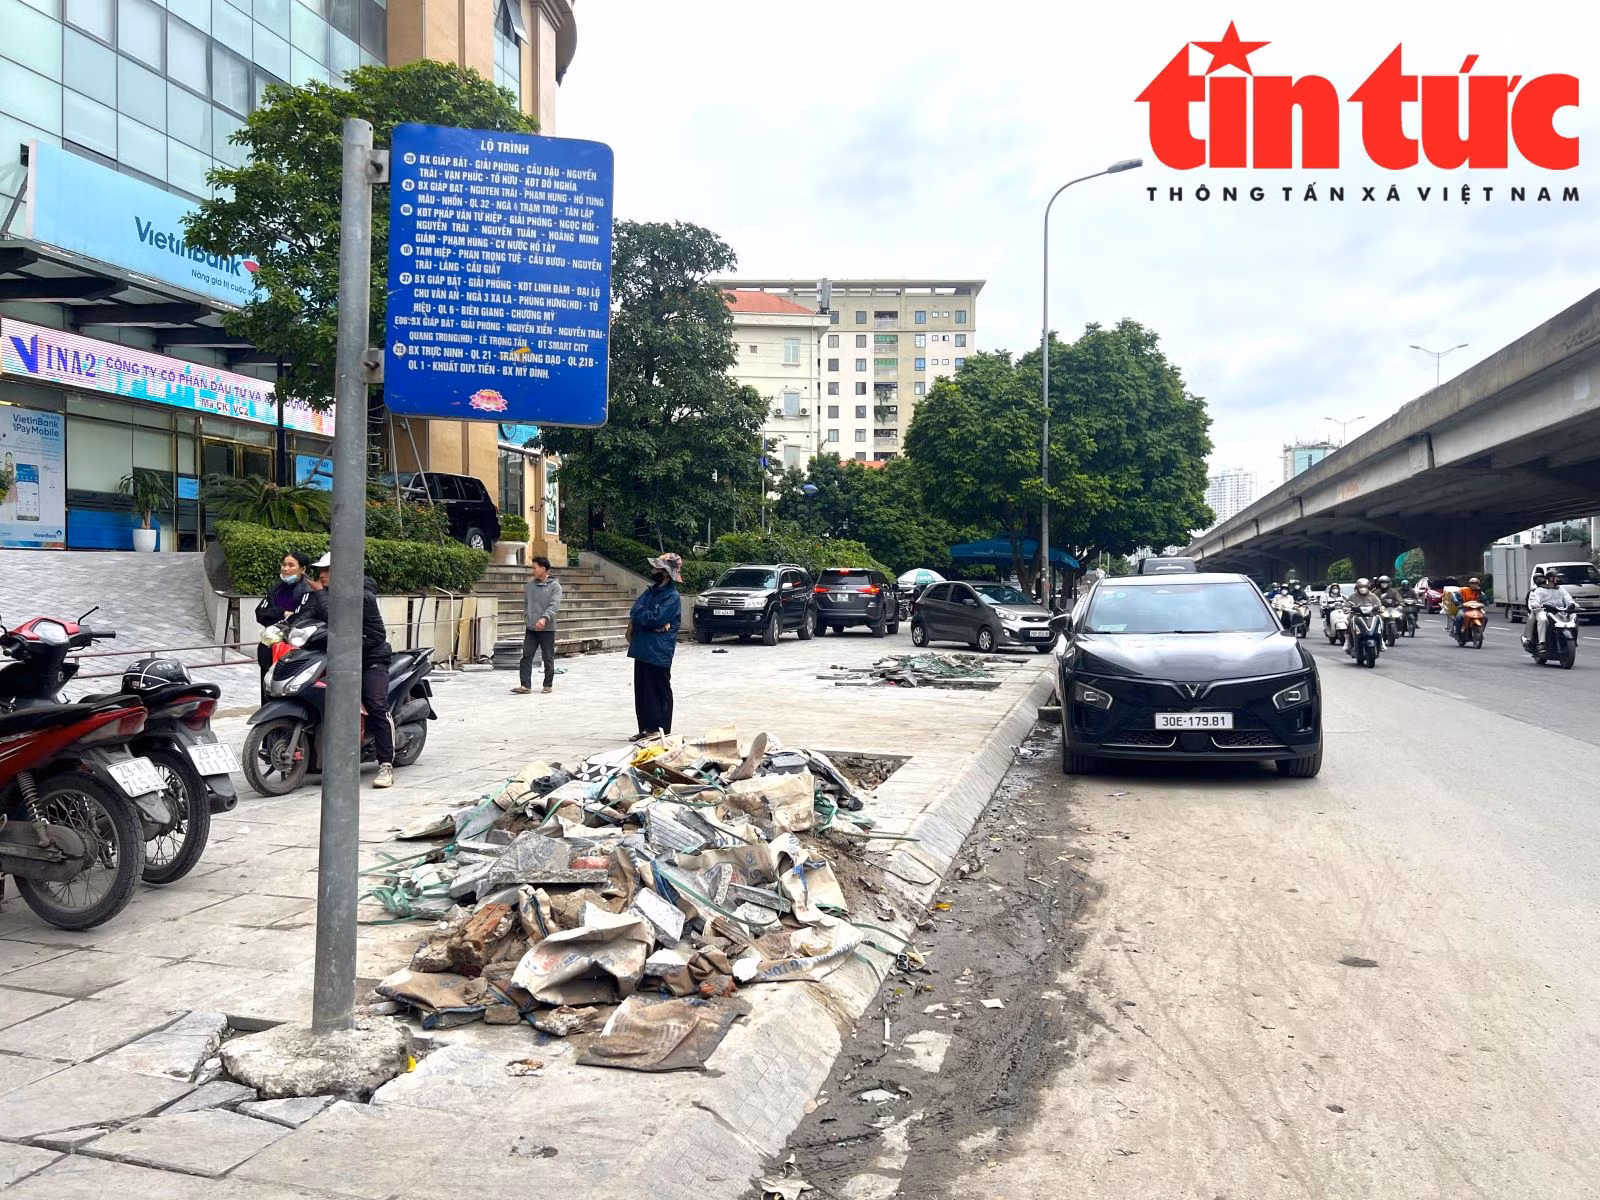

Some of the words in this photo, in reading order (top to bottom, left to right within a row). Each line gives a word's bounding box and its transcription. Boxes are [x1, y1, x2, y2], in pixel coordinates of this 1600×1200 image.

[480, 138, 493, 154] LỘ
[497, 140, 528, 154] TRÌNH
[420, 155, 430, 164] BX
[418, 181, 428, 190] BX
[470, 198, 478, 208] QL
[481, 200, 489, 208] 32
[434, 207, 454, 218] PHÁP
[496, 240, 505, 249] CV
[579, 234, 598, 244] MINH
[416, 246, 432, 256] TAM
[459, 250, 479, 259] PHAN
[415, 274, 425, 284] BX
[534, 283, 551, 293] LINH
[414, 288, 429, 298] CHU
[484, 293, 488, 302] 3
[491, 294, 500, 303] XA
[503, 295, 512, 304] LA
[438, 304, 447, 314] QL
[449, 306, 454, 314] 6
[481, 308, 504, 317] GIANG
[409, 331, 433, 340] QUANG
[548, 341, 572, 350] SMART
[574, 343, 588, 352] CITY
[408, 346, 419, 355] BX
[444, 348, 463, 358] NINH
[471, 350, 480, 359] QL
[482, 351, 491, 359] 21
[568, 356, 577, 366] QL
[579, 358, 594, 367] 21B
[106, 356, 140, 374] CÔNG
[142, 364, 157, 377] TY
[408, 360, 418, 370] QL
[421, 361, 424, 370] 1
[460, 363, 475, 373] DUY
[503, 366, 513, 376] BX
[13, 414, 59, 428] VietinBank
[31, 426, 59, 437] Mobile
[1162, 716, 1225, 726] 30E-179.81
